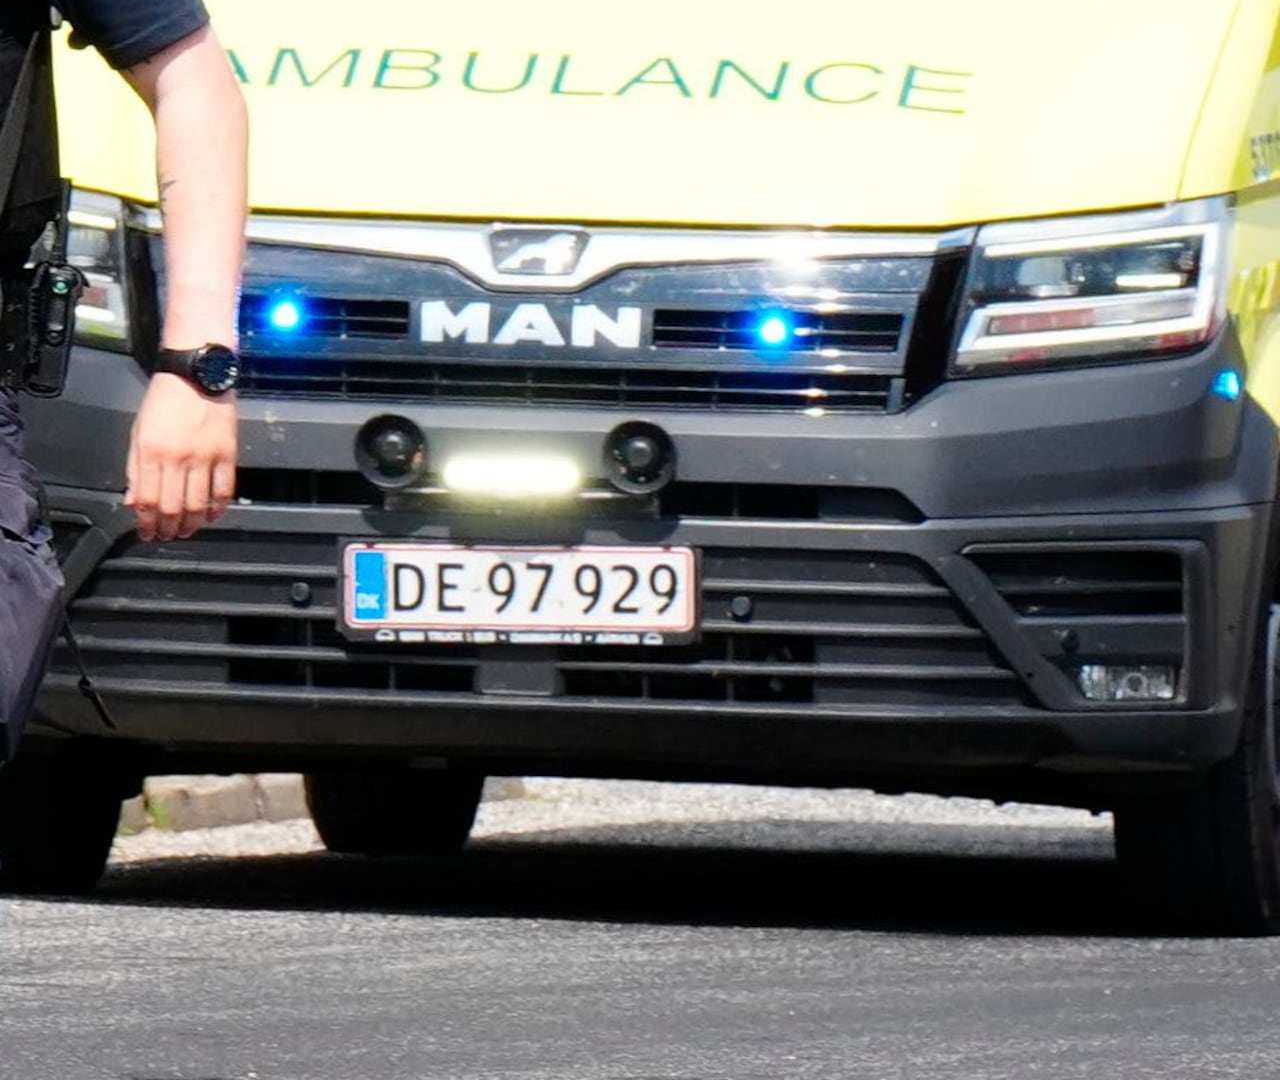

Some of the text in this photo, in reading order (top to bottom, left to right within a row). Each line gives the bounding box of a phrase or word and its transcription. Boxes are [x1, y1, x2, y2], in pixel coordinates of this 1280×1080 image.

[419, 300, 643, 348] MAN
[392, 561, 678, 616] DE 97 929
